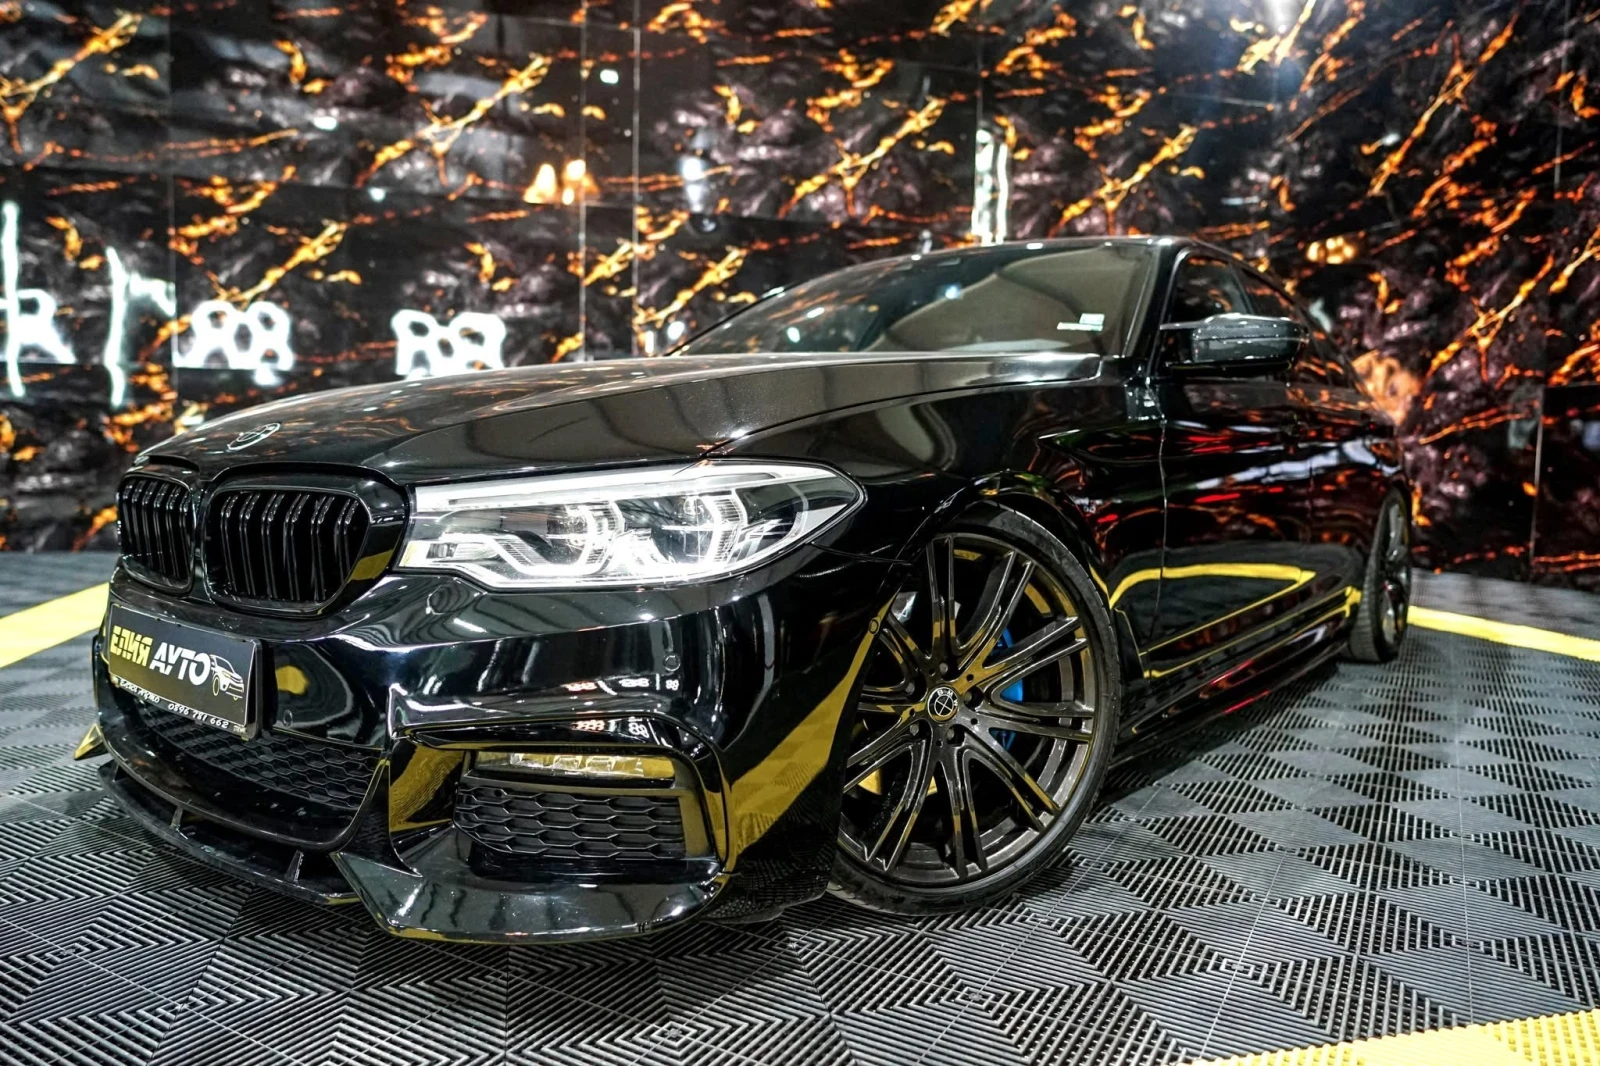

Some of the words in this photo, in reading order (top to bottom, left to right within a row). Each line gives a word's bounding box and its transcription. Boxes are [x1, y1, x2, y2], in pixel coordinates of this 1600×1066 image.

[167, 703, 190, 716] 0896
[192, 709, 208, 721] 781
[209, 716, 230, 729] 662
